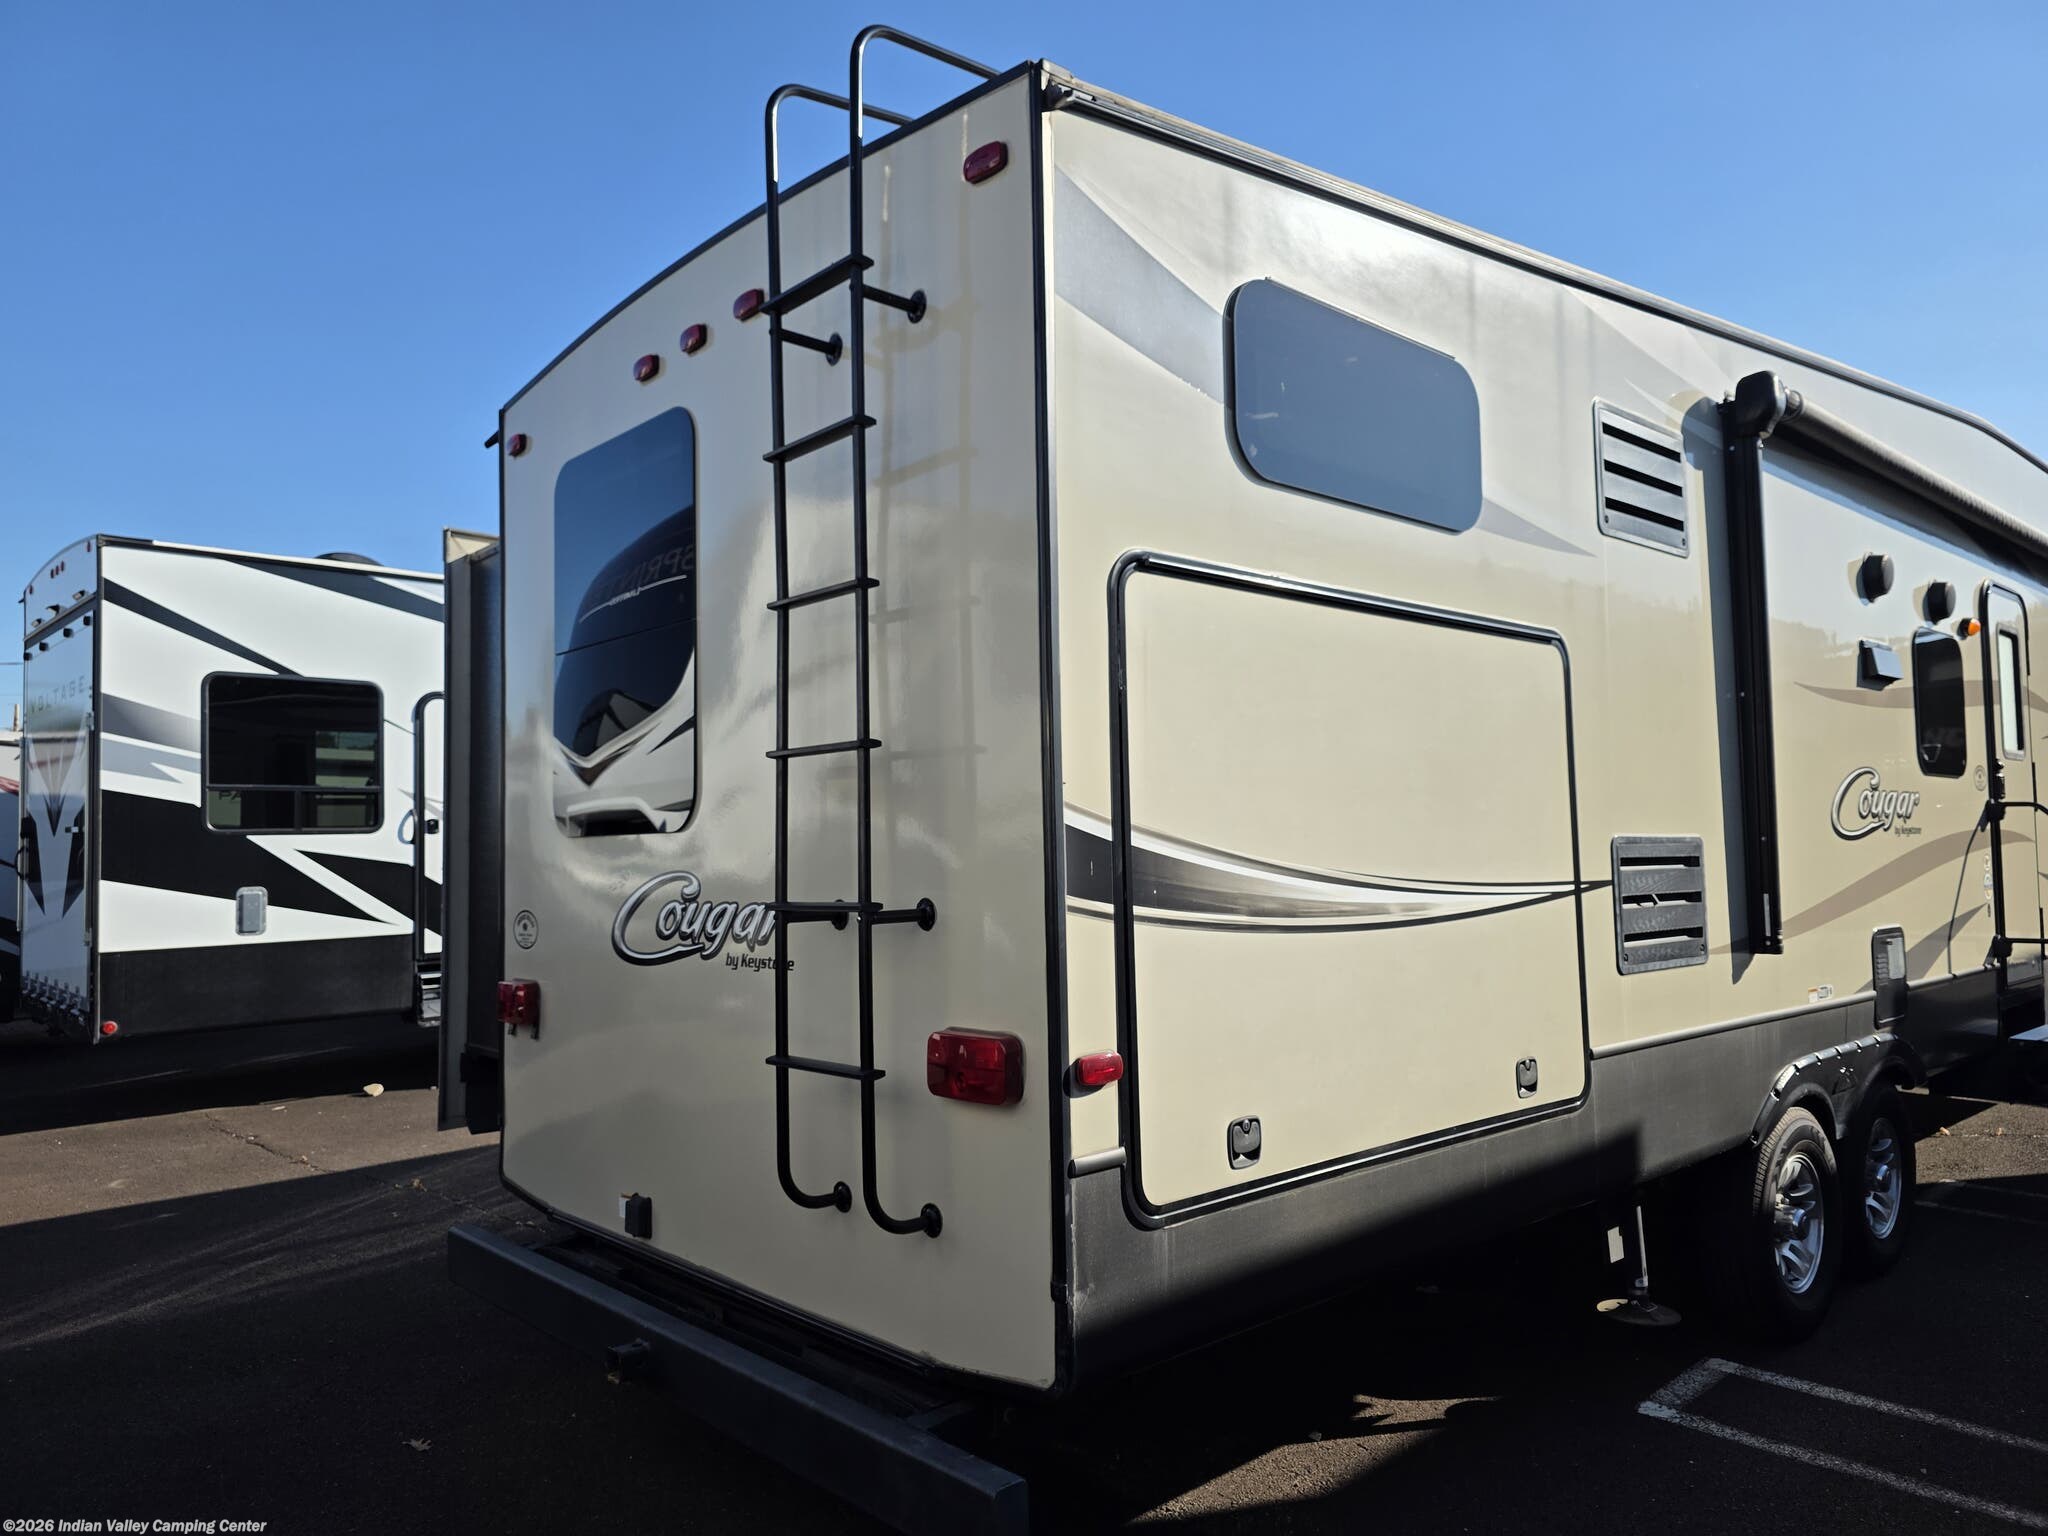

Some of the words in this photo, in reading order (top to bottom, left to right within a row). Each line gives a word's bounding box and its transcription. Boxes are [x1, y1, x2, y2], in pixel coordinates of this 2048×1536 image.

[1831, 767, 1920, 841] Cougar
[725, 952, 739, 970] by
[741, 953, 795, 972] Keyste
